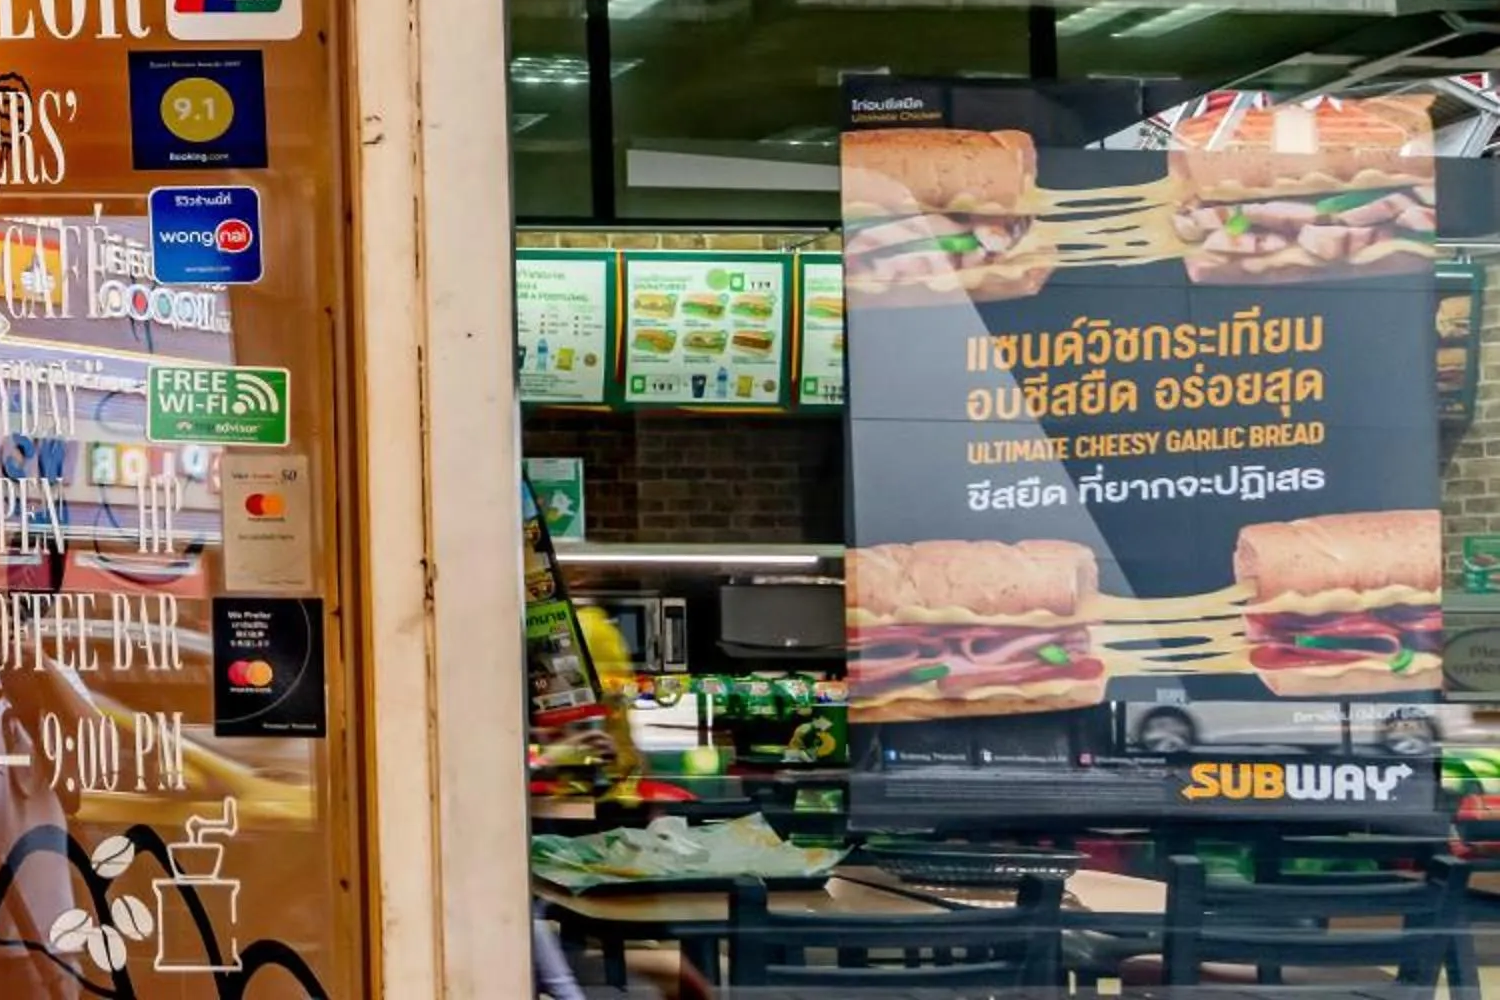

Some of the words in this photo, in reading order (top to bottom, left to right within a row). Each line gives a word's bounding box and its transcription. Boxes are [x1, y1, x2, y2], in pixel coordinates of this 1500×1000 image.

[172, 96, 216, 122] 9.1
[966, 305, 1323, 373] แซนด์วิชกระเทียม
[157, 369, 228, 393] FREE
[158, 393, 228, 415] WI-FI
[966, 369, 1138, 421] อบชีสยืด
[1155, 363, 1323, 418] อร่อยสุด
[966, 436, 1069, 466] ULTIMATE
[1075, 431, 1160, 460] CHEESY
[1165, 426, 1246, 455] GARLIC
[1249, 421, 1325, 450] BREAD
[966, 475, 1068, 512] ชีสยืด
[1078, 464, 1326, 506] ที่ยากจะปฏิเสธ
[112, 590, 183, 672] BAR
[43, 710, 120, 793] 9:00
[133, 710, 186, 792] PM
[1180, 761, 1414, 802] SUBWAY
